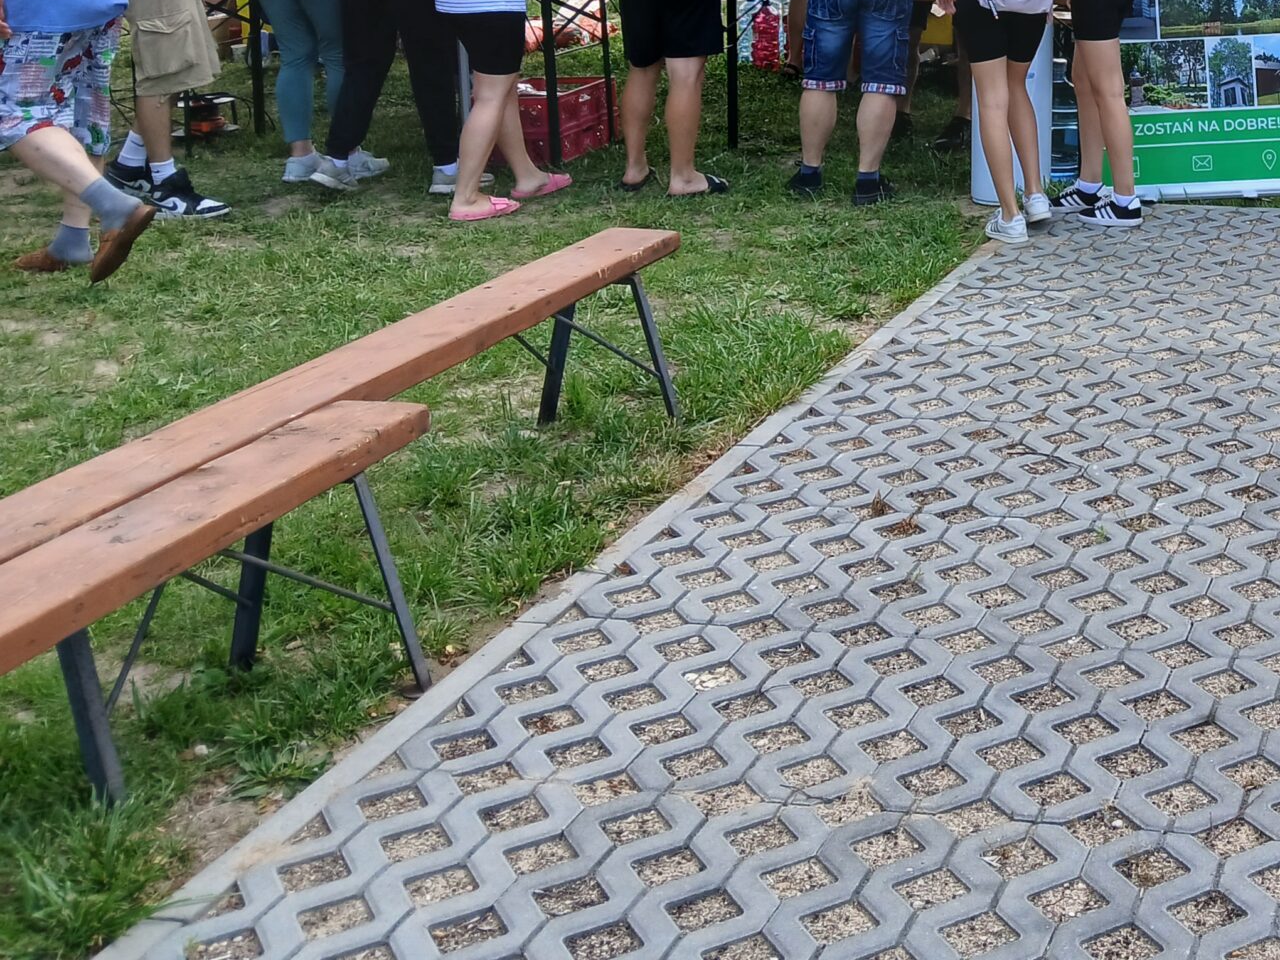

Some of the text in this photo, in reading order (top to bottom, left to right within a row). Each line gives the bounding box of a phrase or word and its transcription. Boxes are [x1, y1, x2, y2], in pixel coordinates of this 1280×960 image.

[1135, 116, 1280, 136] ZOSTAŃ NA DOBRE!
